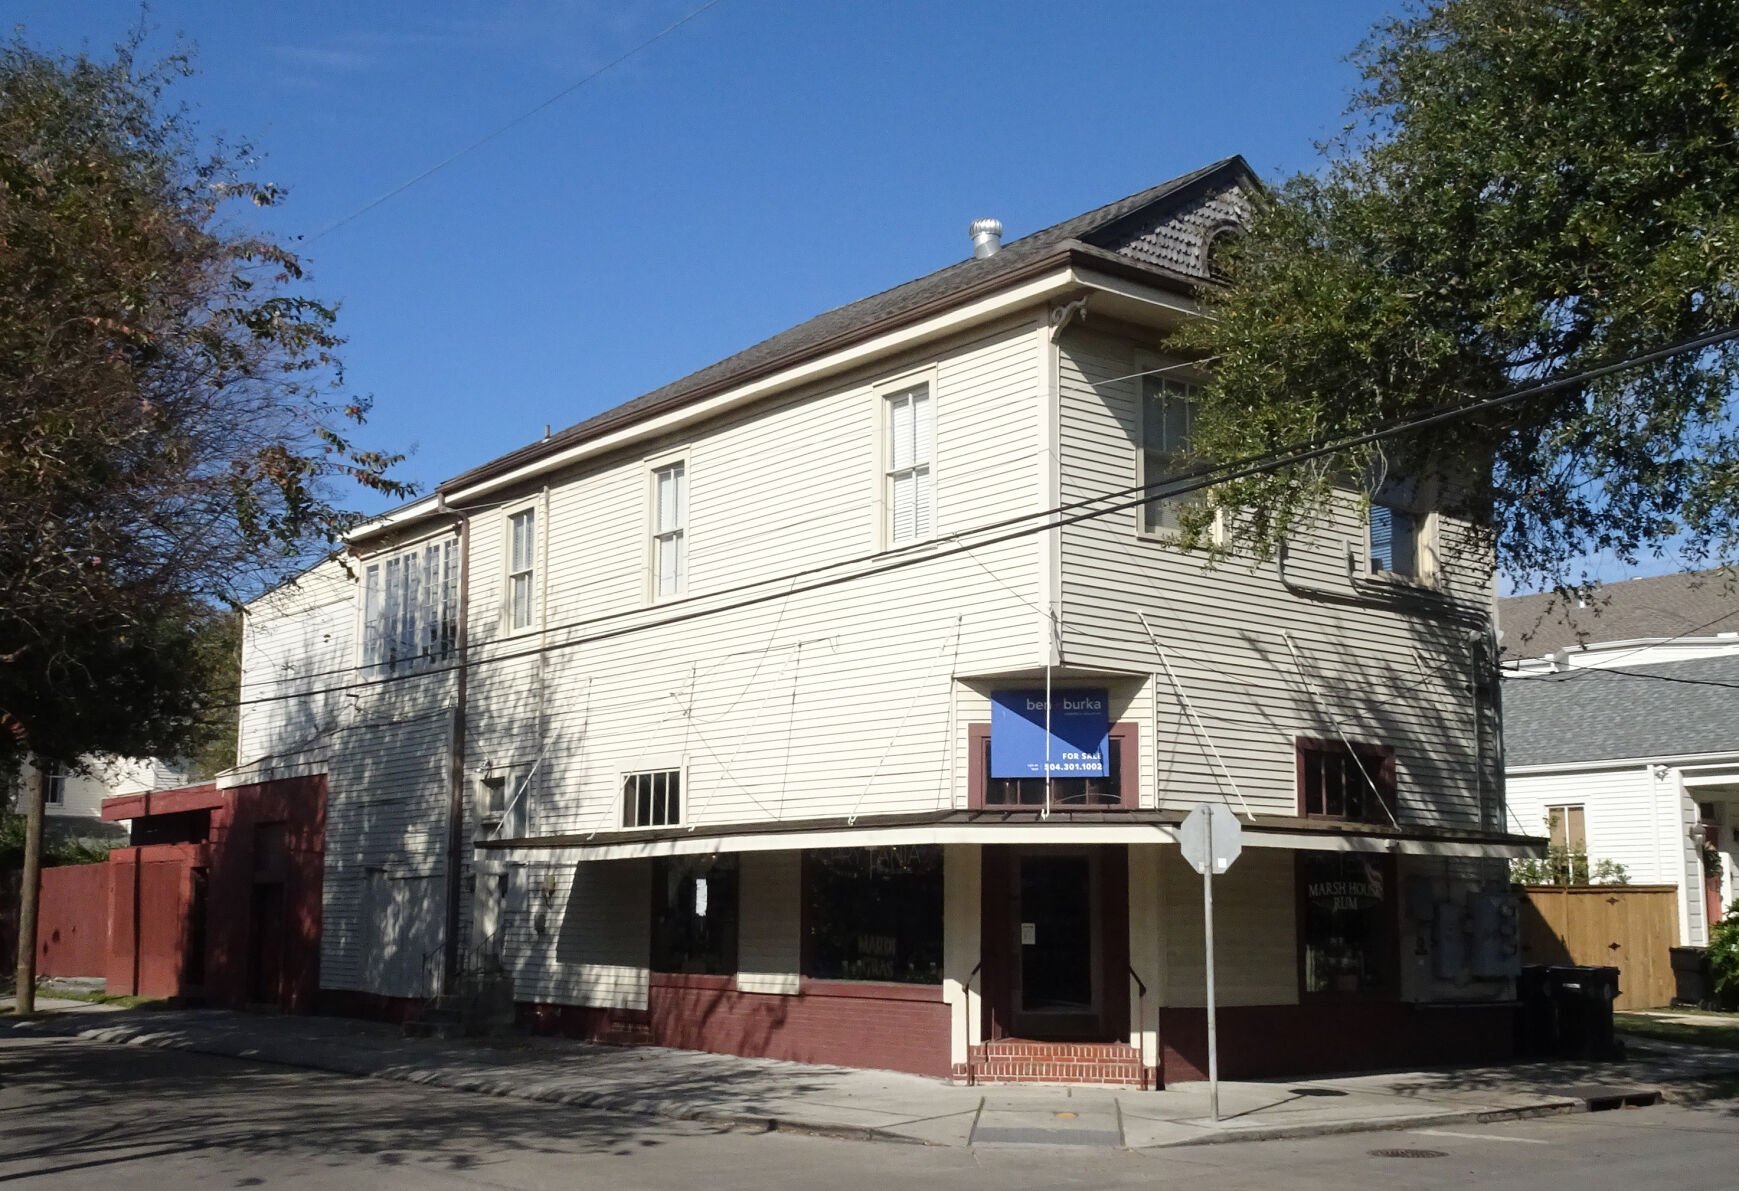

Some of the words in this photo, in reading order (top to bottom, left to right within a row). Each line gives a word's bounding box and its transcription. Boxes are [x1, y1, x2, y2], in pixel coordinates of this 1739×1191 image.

[1063, 698, 1101, 710] burka
[1062, 752, 1079, 760] FOR
[1081, 752, 1101, 760] SALE
[1308, 881, 1346, 897] MARSH
[1332, 896, 1358, 912] RUM
